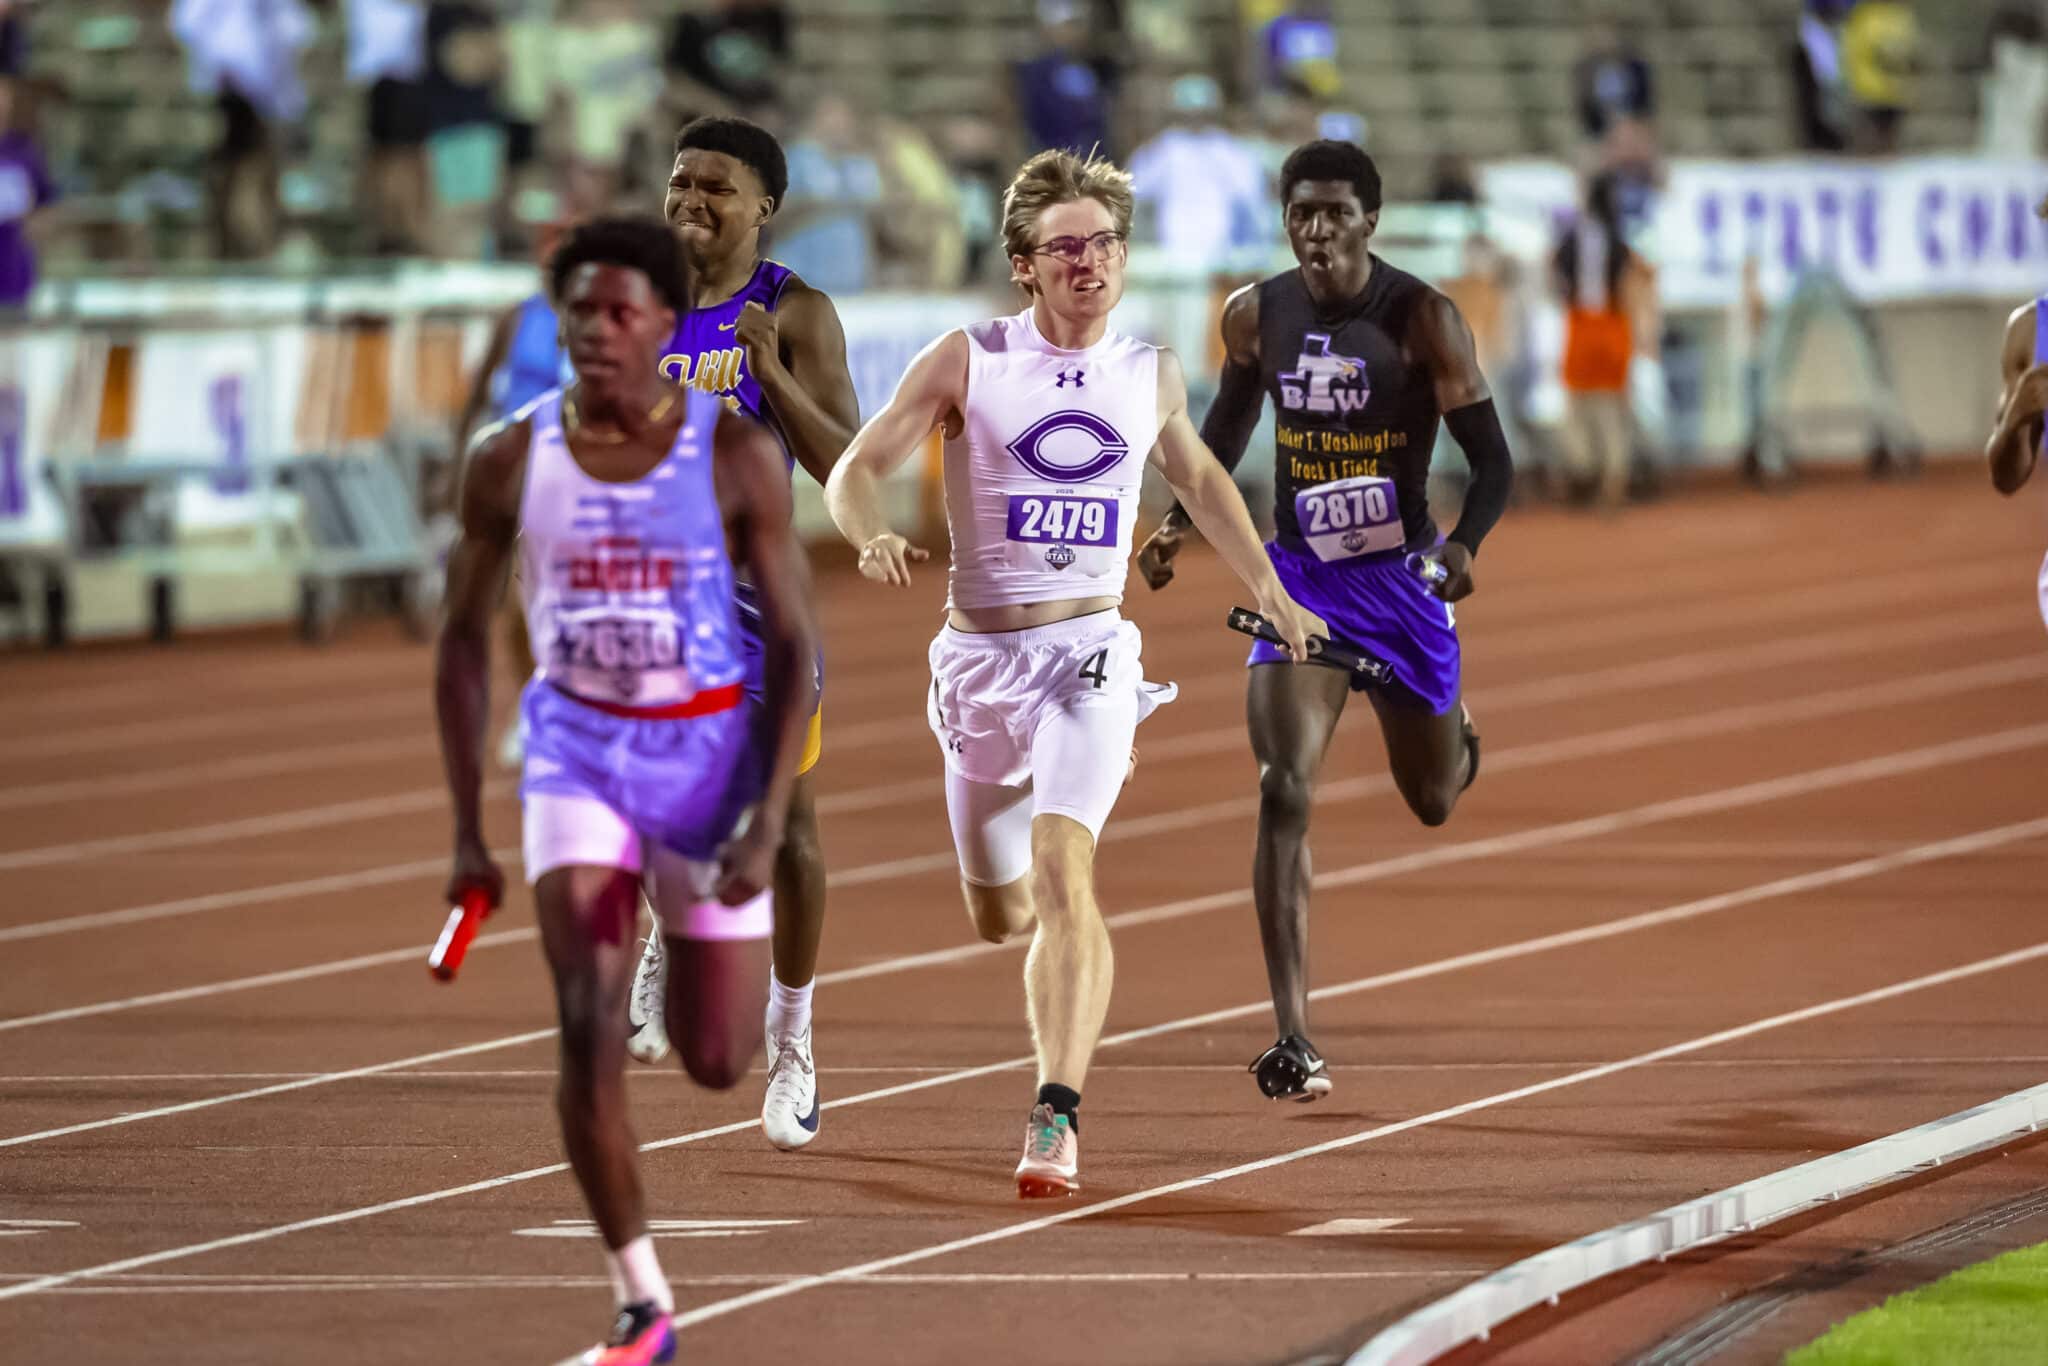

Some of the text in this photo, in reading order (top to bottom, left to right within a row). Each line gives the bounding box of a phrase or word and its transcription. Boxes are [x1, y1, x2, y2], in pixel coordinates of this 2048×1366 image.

[658, 347, 744, 393] Hill
[1321, 430, 1408, 453] Washington
[1291, 456, 1326, 480] Track
[1342, 458, 1378, 478] Field
[1019, 498, 1106, 541] 2479
[1306, 486, 1389, 533] 2870
[1079, 648, 1108, 688] 4
